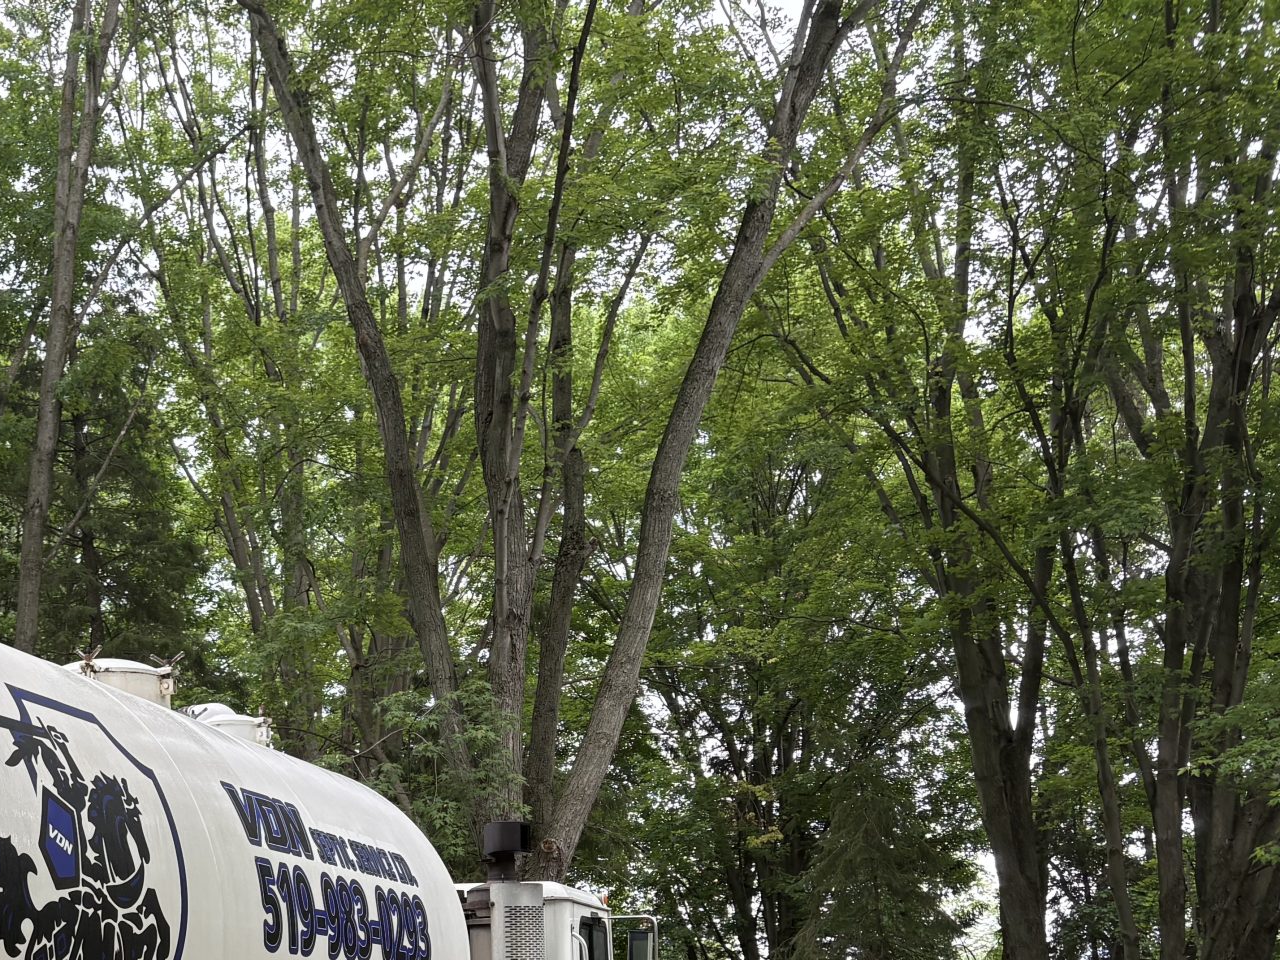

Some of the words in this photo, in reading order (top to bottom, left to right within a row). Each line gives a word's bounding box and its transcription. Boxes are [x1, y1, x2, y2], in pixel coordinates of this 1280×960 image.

[48, 823, 73, 855] VDN
[220, 780, 314, 860] VDN
[308, 827, 357, 872] SEPTIC
